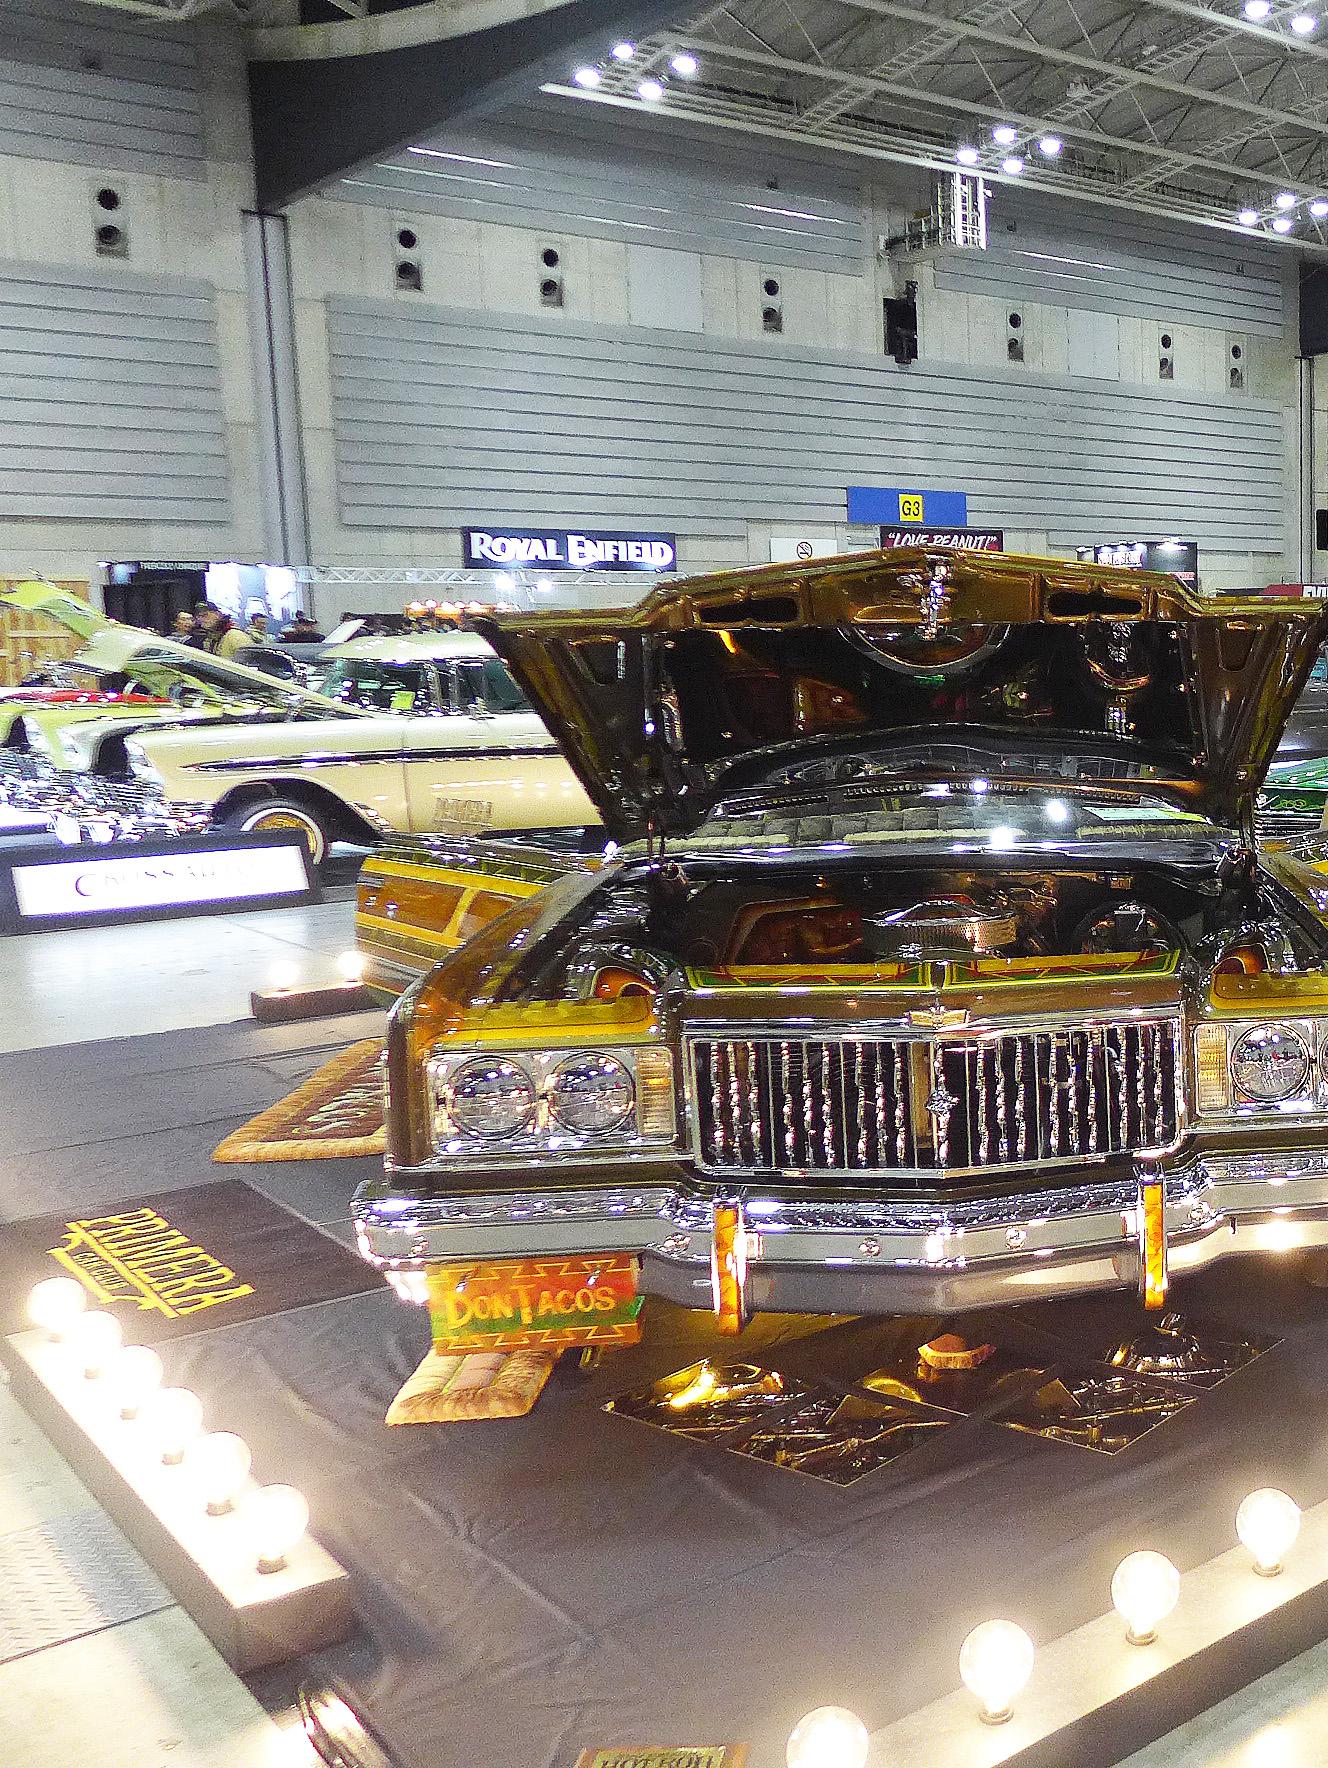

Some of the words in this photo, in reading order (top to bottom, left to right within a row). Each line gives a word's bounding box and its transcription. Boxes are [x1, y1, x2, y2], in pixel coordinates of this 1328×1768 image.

[902, 500, 921, 517] G3
[470, 532, 564, 562] ROYAL
[567, 534, 674, 566] ENFIELD
[72, 1207, 255, 1316] PRIMERA
